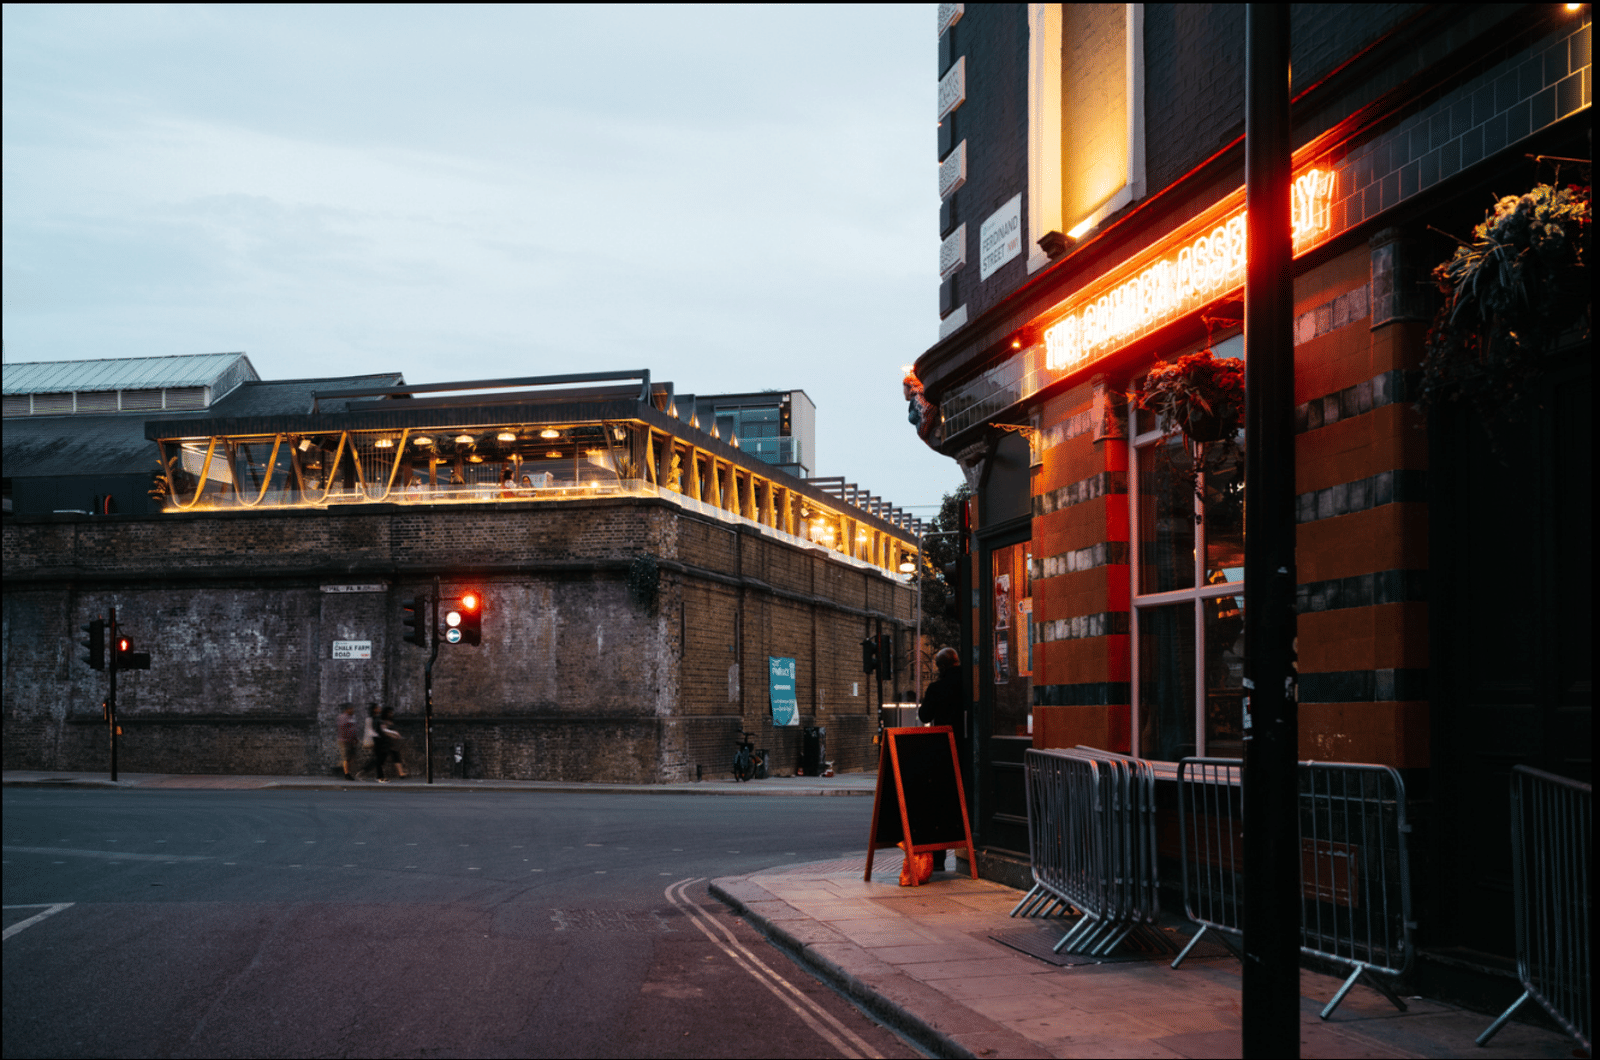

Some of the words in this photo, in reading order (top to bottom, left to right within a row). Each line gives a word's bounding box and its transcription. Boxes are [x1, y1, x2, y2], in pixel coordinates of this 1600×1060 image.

[982, 215, 1019, 254] FERDINAND
[982, 242, 1006, 272] STREET
[1044, 314, 1080, 370] THE
[1082, 260, 1171, 349] CAMDEN
